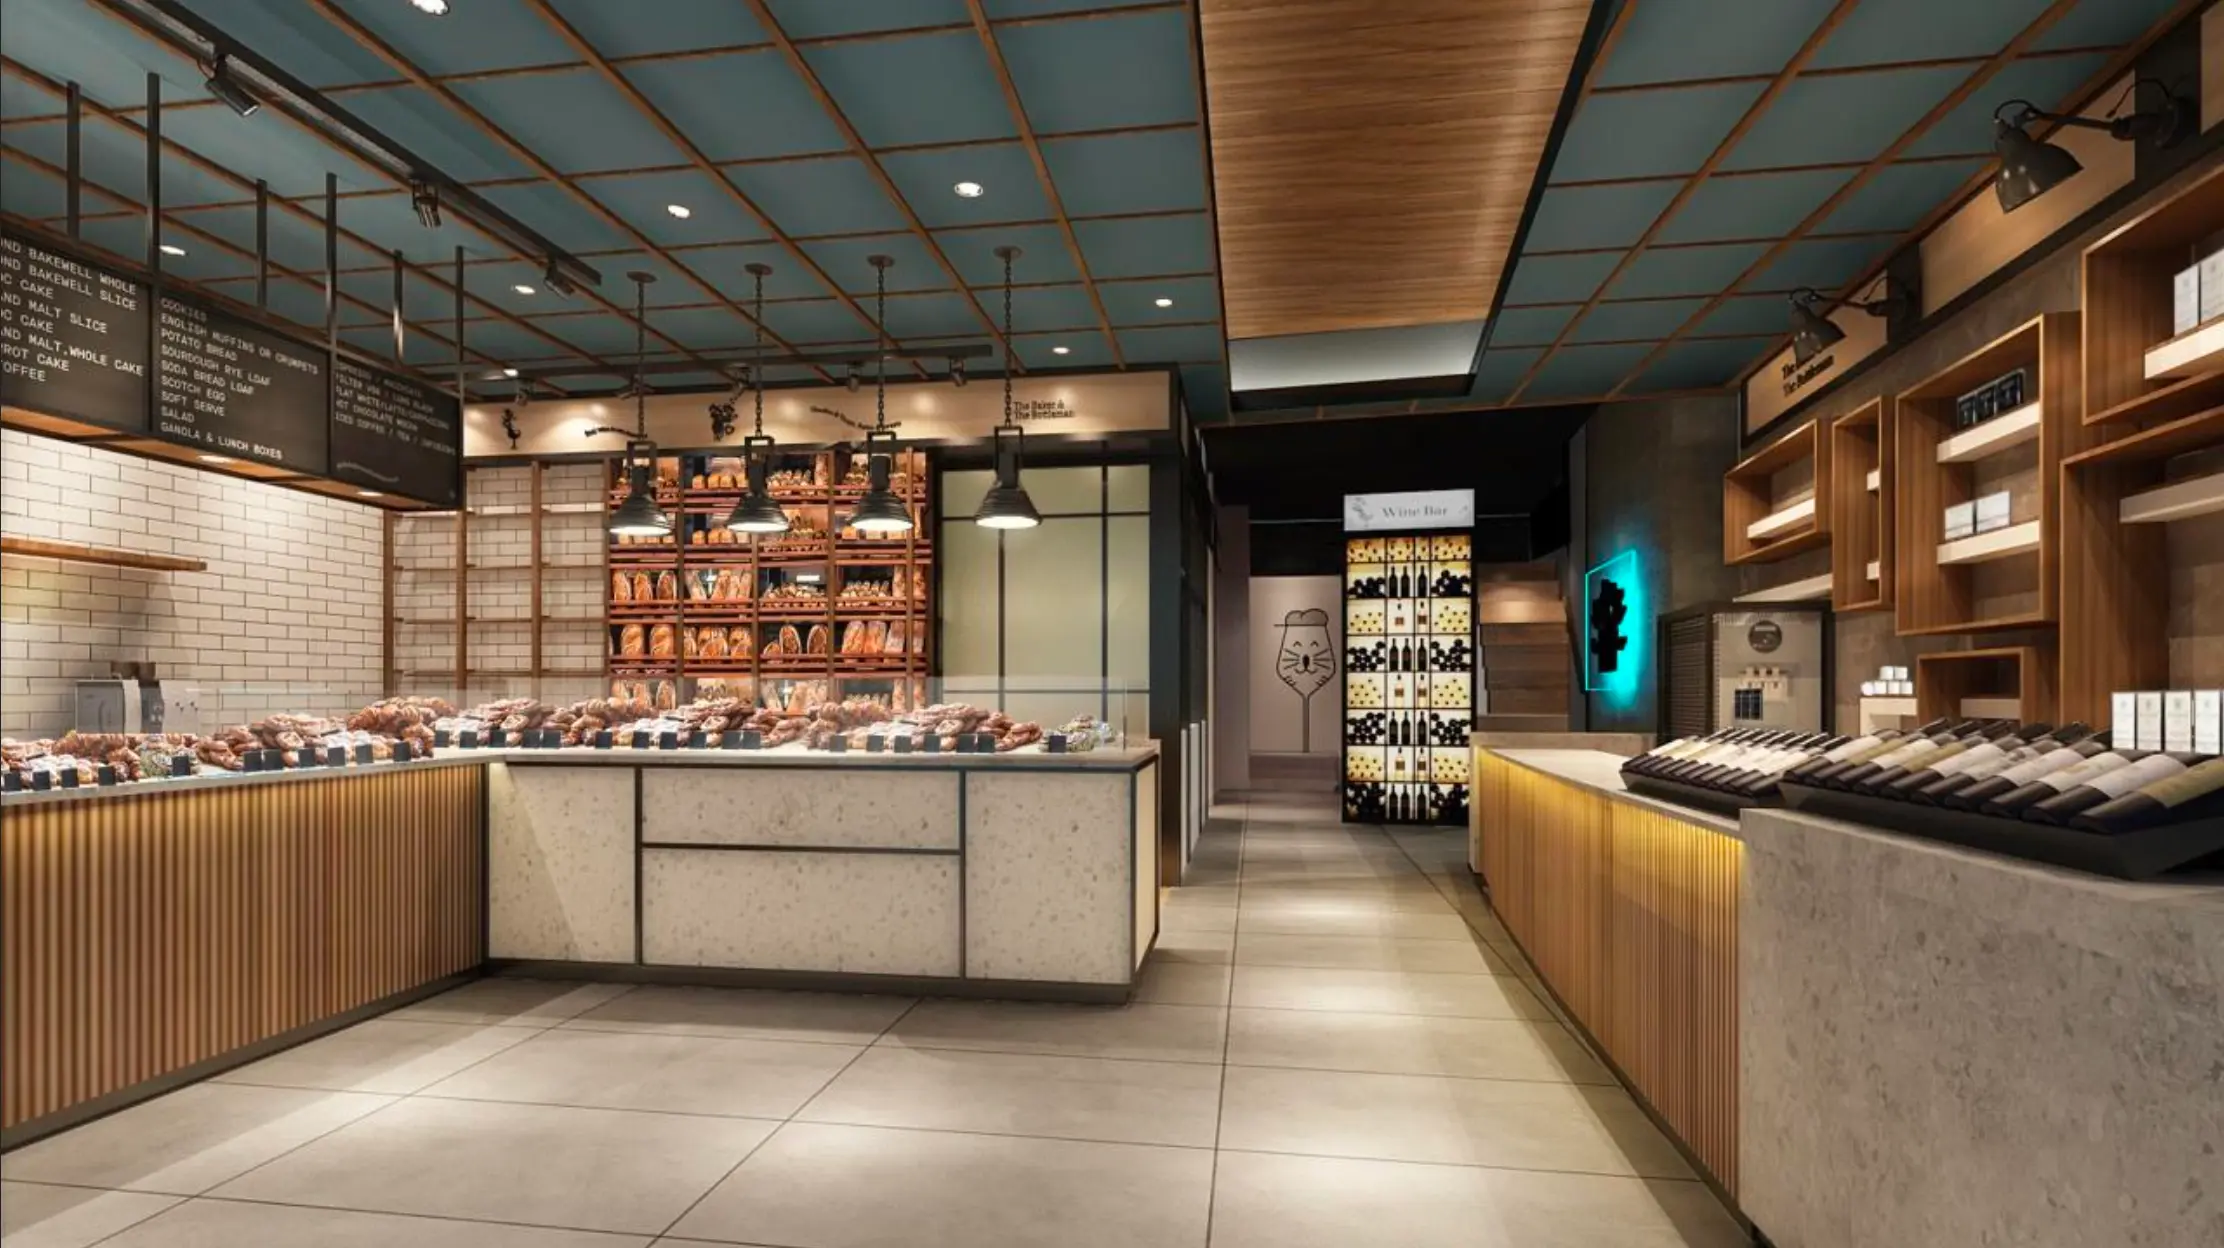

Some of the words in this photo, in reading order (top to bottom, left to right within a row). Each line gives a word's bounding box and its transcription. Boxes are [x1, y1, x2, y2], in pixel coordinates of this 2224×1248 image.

[28, 247, 92, 280] BAKEWELL
[99, 272, 137, 295] WHOLE
[20, 279, 54, 300] CAKE
[28, 264, 92, 297] BAKEWELL
[99, 289, 137, 311] SLICE
[28, 299, 62, 319] MALT
[70, 312, 107, 334] SLICE
[161, 297, 207, 322] COOKIES
[20, 314, 54, 334] CAKE
[161, 312, 207, 337] ENGLISH
[212, 331, 254, 354] MUFFINS
[259, 346, 271, 359] OR
[161, 328, 201, 349] POTATO
[206, 343, 238, 361] BREAD
[1, 360, 47, 382] OFFEE
[36, 353, 69, 372] CAKE
[113, 359, 144, 377] CAKE
[161, 344, 219, 372] SOURDOUGH
[224, 364, 243, 379] RYE
[247, 373, 272, 386] LOAF
[161, 359, 188, 376] SODA
[193, 370, 226, 387] BREAD
[230, 381, 255, 395] LOAF
[161, 375, 201, 394] SCOTCH
[206, 388, 227, 403] EGG
[161, 391, 188, 407] SOFT
[193, 399, 226, 417] SERVE
[161, 406, 195, 423] SALAD
[1013, 401, 1030, 411] The
[160, 421, 201, 440] GANOLA
[205, 431, 213, 443] &
[218, 435, 249, 451] LUNCH
[253, 444, 283, 460] BOXES
[1382, 506, 1420, 518] Wine
[1424, 504, 1448, 517] Bar
